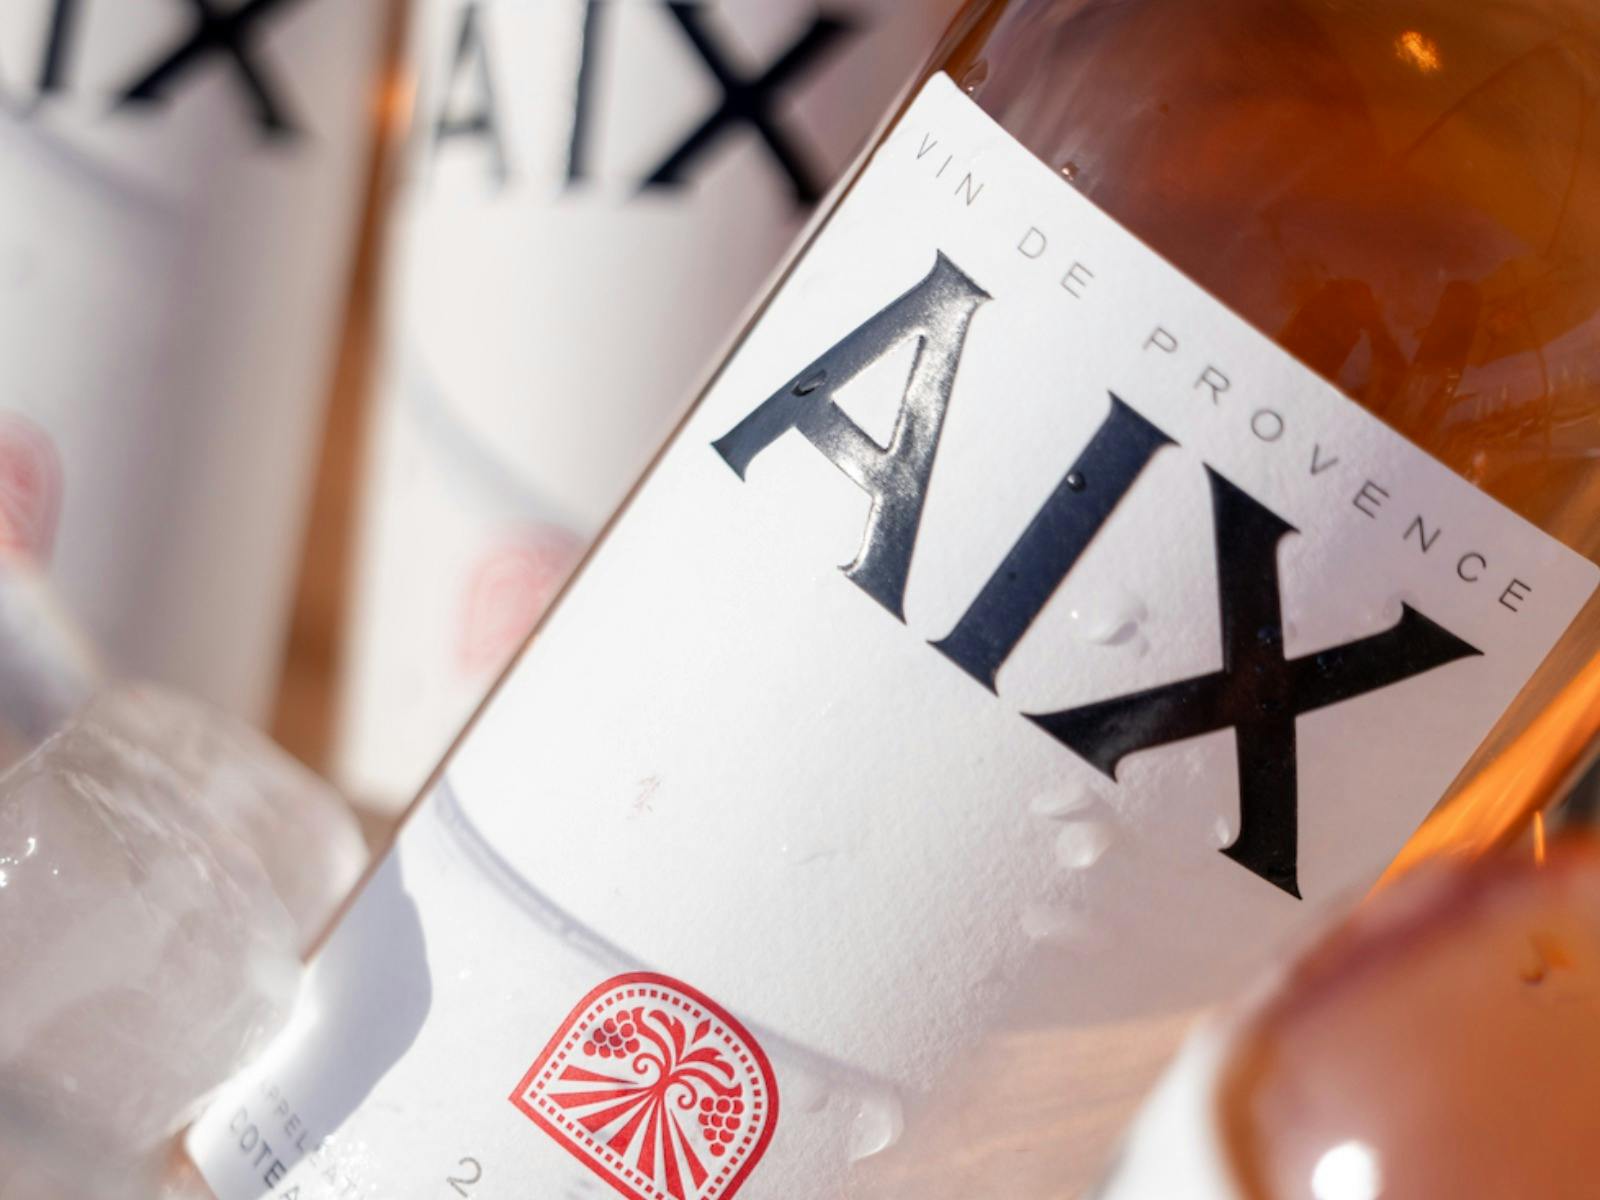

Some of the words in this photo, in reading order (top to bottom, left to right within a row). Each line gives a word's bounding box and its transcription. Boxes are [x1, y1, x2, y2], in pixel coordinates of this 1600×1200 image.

[424, 0, 870, 206] AIX
[915, 132, 985, 207] VIN
[1016, 226, 1095, 299] DE
[1142, 326, 1533, 613] PROVENCE
[710, 248, 1485, 901] AIX
[446, 1156, 483, 1199] 2
